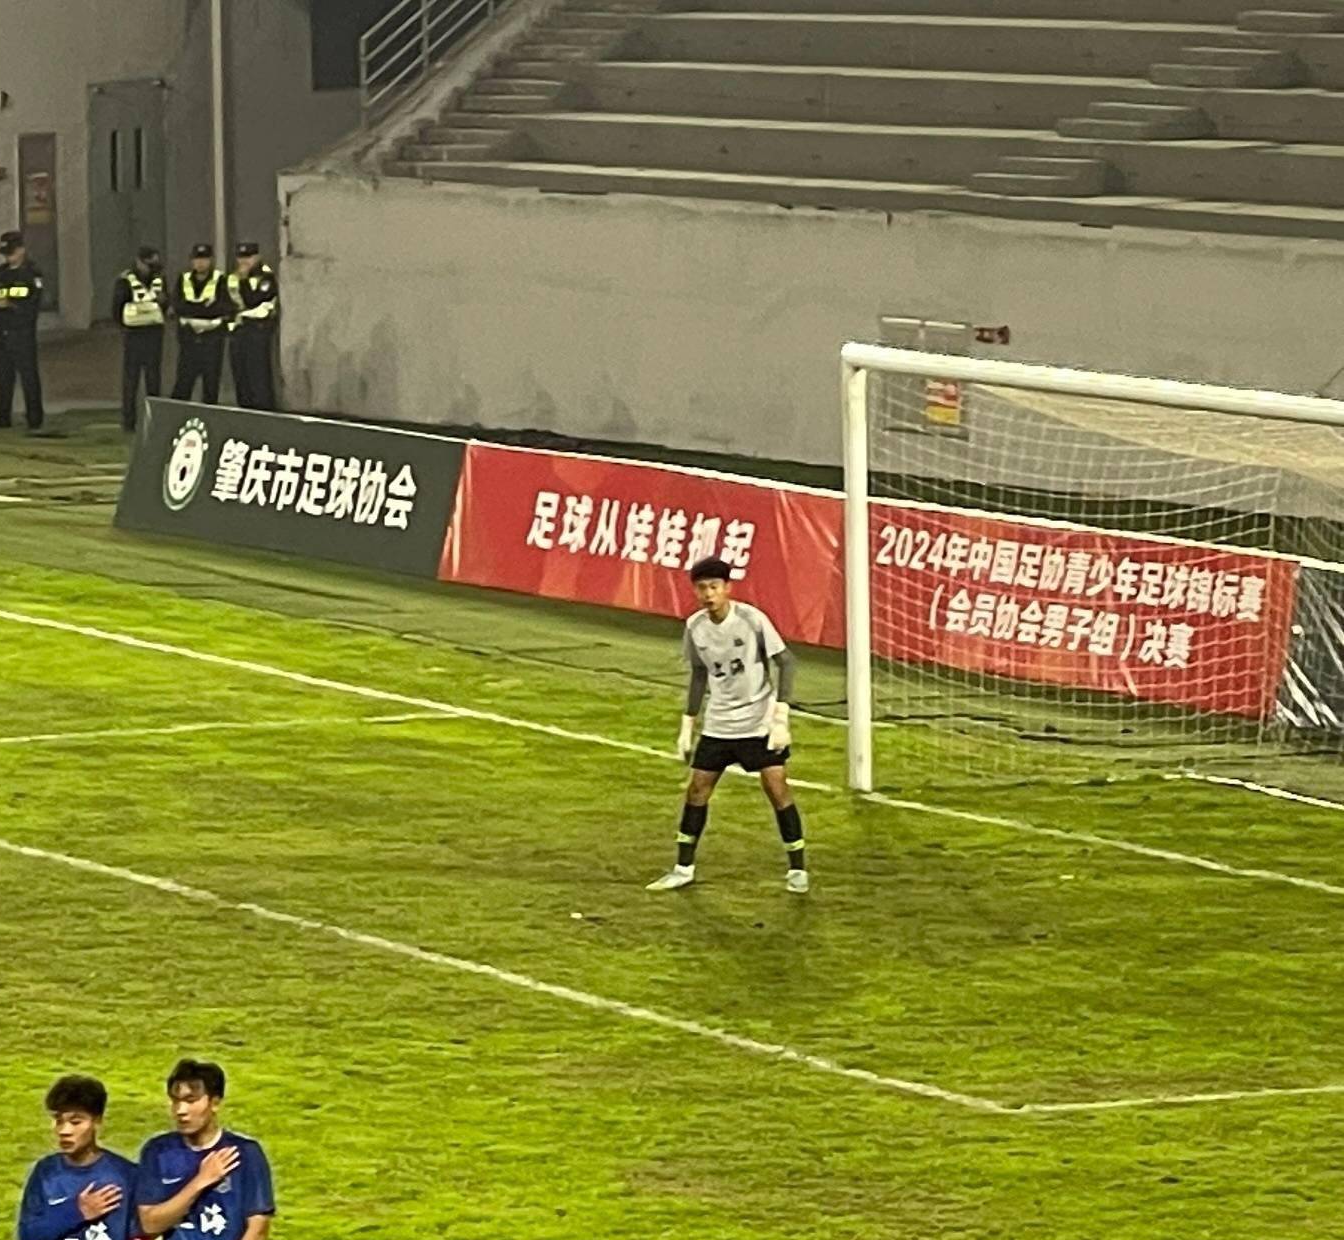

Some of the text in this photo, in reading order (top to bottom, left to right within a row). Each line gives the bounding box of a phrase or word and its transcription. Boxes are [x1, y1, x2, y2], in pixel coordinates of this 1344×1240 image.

[210, 438, 417, 530] 肇庆市足球协会
[526, 491, 755, 580] 足球从娃娃抓起
[875, 526, 1266, 623] 2024年中国足协青少年足球锦标赛
